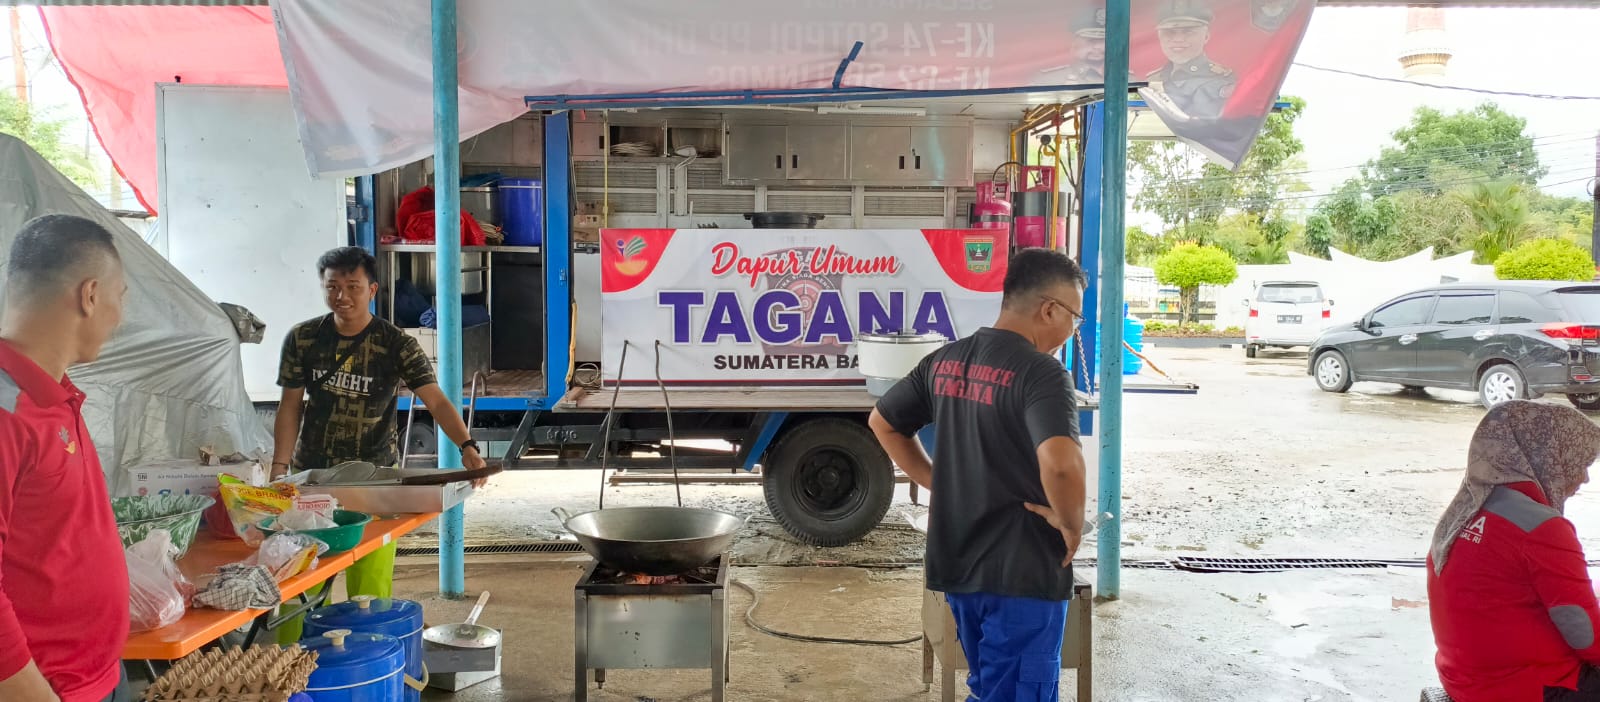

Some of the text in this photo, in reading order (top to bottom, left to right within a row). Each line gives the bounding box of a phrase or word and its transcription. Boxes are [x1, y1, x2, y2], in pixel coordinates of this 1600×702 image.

[710, 241, 902, 291] Dapur Umum
[658, 290, 958, 345] TAGANA
[713, 354, 830, 370] SUMATERA
